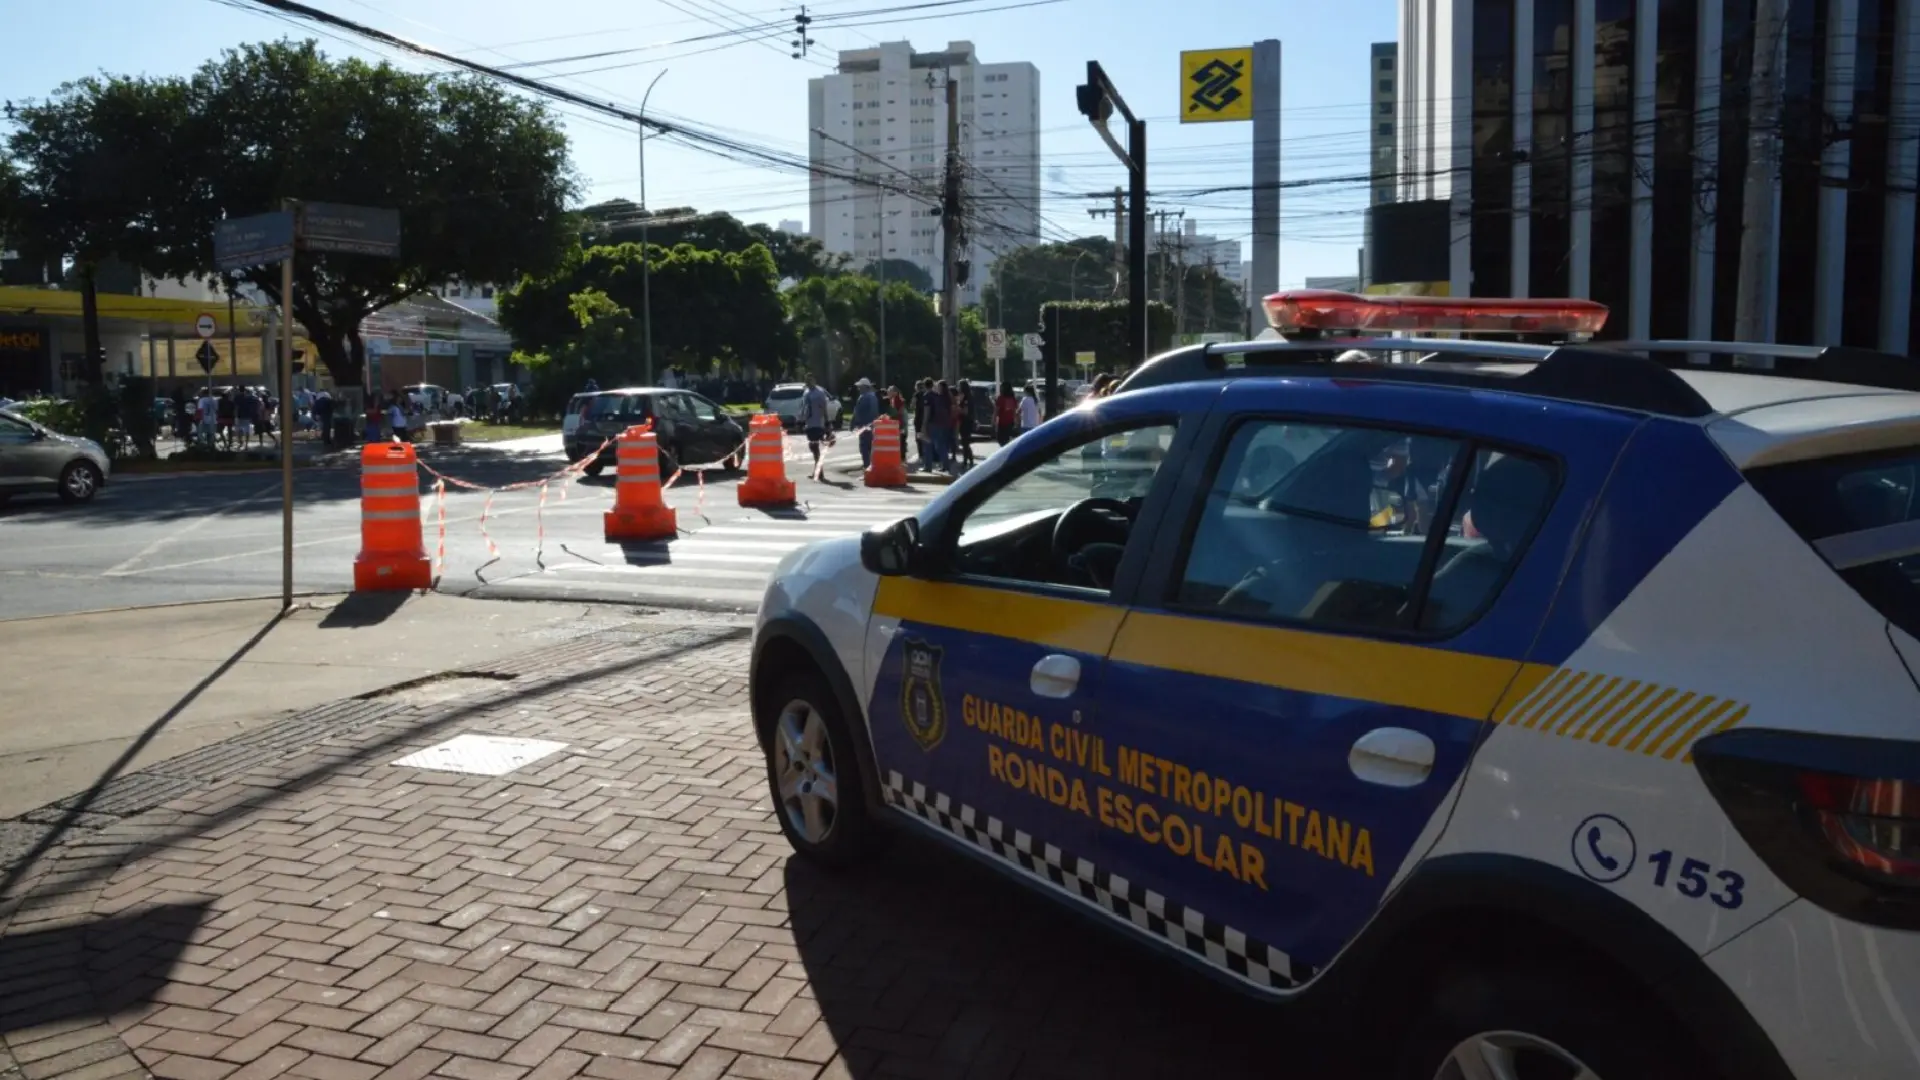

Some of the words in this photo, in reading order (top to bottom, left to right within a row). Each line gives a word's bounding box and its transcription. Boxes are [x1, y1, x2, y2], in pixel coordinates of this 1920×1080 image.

[962, 693, 1044, 752] GUARDA
[1051, 722, 1111, 777] CIVIL
[1117, 745, 1374, 877] METROPOLITANA
[988, 744, 1093, 818] RONDA
[1097, 785, 1268, 891] ESCOLAR
[1648, 848, 1746, 910] 153
